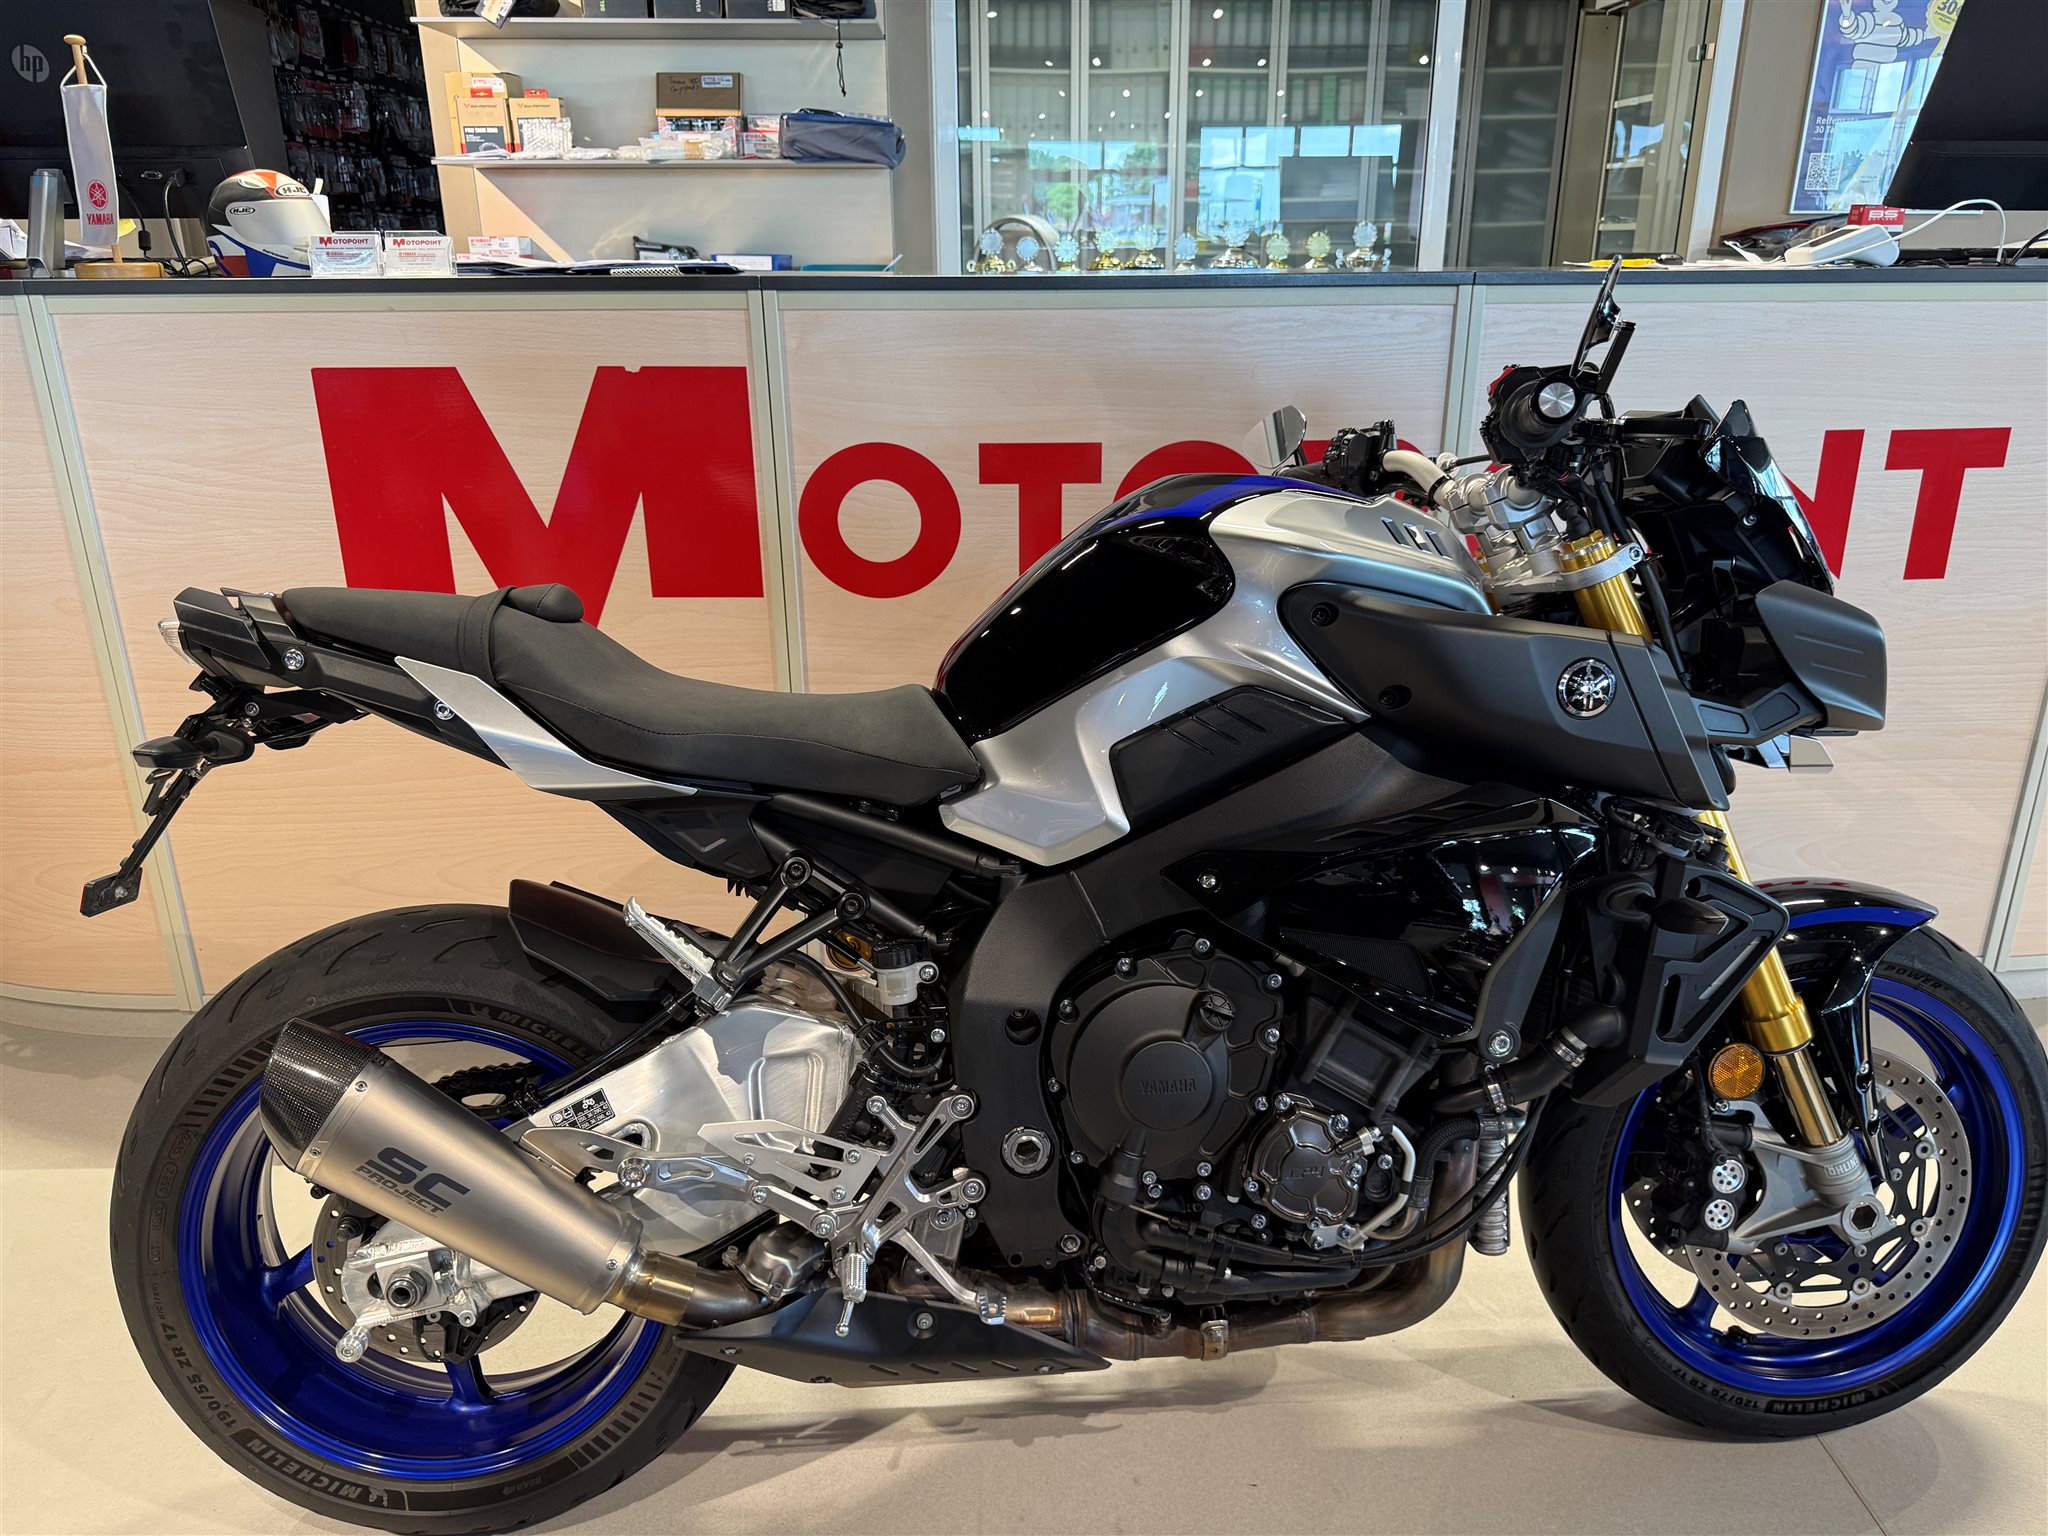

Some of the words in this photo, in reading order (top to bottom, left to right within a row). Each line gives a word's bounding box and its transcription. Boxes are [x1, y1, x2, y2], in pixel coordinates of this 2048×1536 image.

[19, 45, 44, 82] hp
[282, 186, 307, 195] HJC
[86, 213, 115, 226] YAMAHA
[1868, 209, 1900, 219] BS
[319, 236, 369, 247] MOTOPOINT
[392, 238, 442, 248] MOTOPOINT
[1883, 964, 1942, 989] POWER
[1138, 1078, 1198, 1096] YAMAHA
[364, 1146, 471, 1208] SC
[354, 1164, 444, 1214] PROJECT
[160, 1319, 178, 1341] 17
[170, 1345, 192, 1369] ZR
[1672, 1368, 1687, 1380] 17
[1689, 1379, 1708, 1393] ZR
[187, 1374, 237, 1429] 190/55
[1710, 1387, 1760, 1410] 120/70
[1772, 1391, 1866, 1413] MICHELIN
[247, 1439, 364, 1500] MICHELIN
